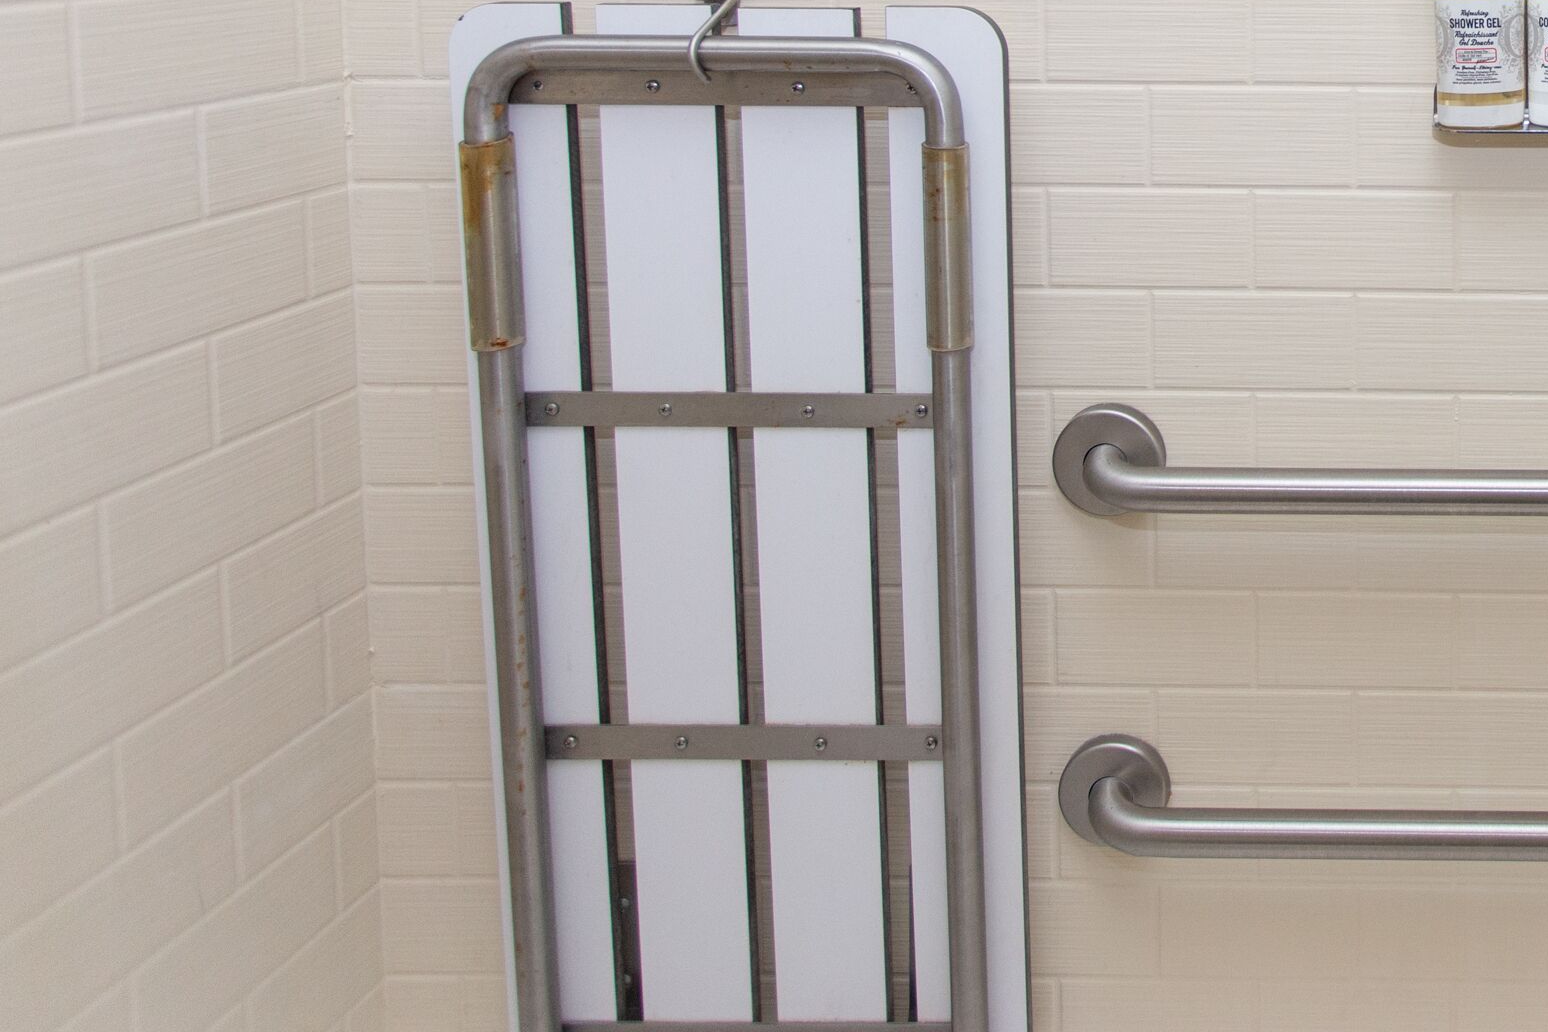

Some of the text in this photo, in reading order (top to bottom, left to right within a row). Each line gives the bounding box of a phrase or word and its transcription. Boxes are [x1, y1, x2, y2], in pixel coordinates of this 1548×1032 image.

[1460, 10, 1489, 18] Refreshing
[1449, 17, 1502, 28] SHOWER GEL
[1470, 38, 1494, 46] Douche
